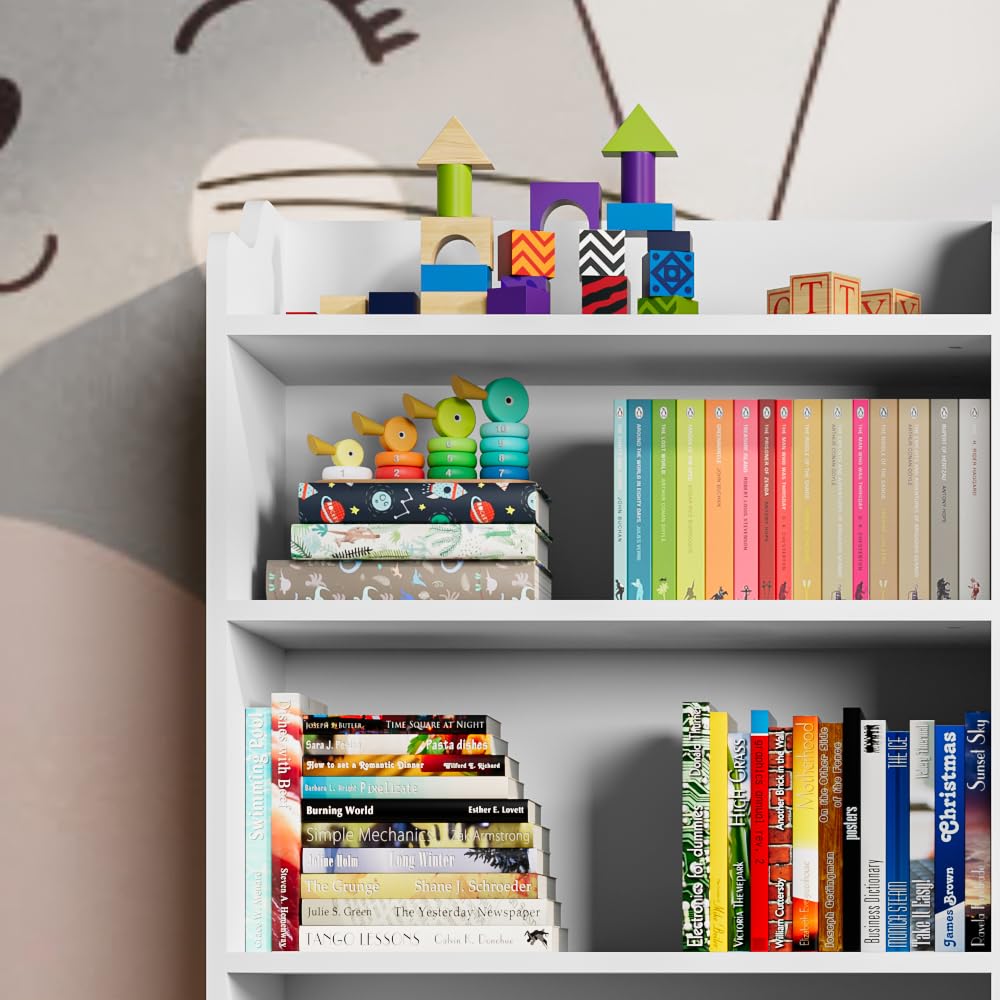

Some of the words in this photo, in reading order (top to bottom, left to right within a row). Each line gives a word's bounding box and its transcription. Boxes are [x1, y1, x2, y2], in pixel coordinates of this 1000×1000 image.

[800, 281, 823, 314] T
[839, 284, 855, 314] T
[394, 469, 400, 477] 2
[500, 469, 504, 477] 7
[248, 713, 266, 749] Pool
[386, 721, 406, 729] TIME
[408, 721, 440, 730] SQUARE
[443, 721, 454, 729] AT
[456, 721, 484, 729] NIGHT
[966, 720, 988, 745] Sky
[426, 739, 454, 750] Pasta
[456, 739, 488, 750] dishes
[776, 731, 785, 749] Wall
[888, 737, 907, 750] ICE
[278, 747, 291, 776] with
[776, 750, 785, 764] the
[795, 723, 815, 810] Motherhood
[888, 753, 907, 769] THE
[966, 749, 986, 792] Sunset
[248, 755, 268, 840] Swimming
[776, 775, 785, 795] Brick
[938, 732, 959, 842] Christmas
[306, 806, 342, 817] Burning
[345, 806, 374, 815] World
[776, 797, 785, 830] Another
[833, 796, 842, 807] of
[819, 809, 829, 823] On
[843, 806, 860, 840] posters
[307, 827, 353, 846] Simple
[360, 827, 432, 842] Mechanics
[473, 829, 530, 845] Armstrong
[688, 806, 704, 858] dummies
[418, 851, 455, 867] Winter
[688, 863, 704, 878] for
[305, 880, 328, 892] The
[332, 880, 380, 895] Grunge
[416, 880, 451, 892] Shane
[456, 880, 465, 893] J.
[469, 880, 532, 892] Schroeder
[864, 859, 884, 903] Dictionary
[911, 880, 934, 906] Easy!
[943, 867, 957, 905] Brown
[280, 895, 288, 904] A.
[775, 878, 786, 917] Cuttersby
[888, 882, 907, 912] STEAM
[307, 907, 330, 917] Julie
[332, 907, 341, 917] S.
[344, 907, 372, 917] Green
[394, 907, 414, 917] The
[419, 907, 472, 920] Yesterday
[478, 907, 540, 920] Newspaper
[688, 883, 704, 947] Electronics
[864, 905, 881, 944] Business
[279, 907, 288, 947] Hemenway
[307, 932, 354, 946] TANGO
[360, 932, 420, 946] LESSONS
[775, 919, 785, 948] William
[911, 921, 932, 947] Take
[943, 910, 957, 947] James
